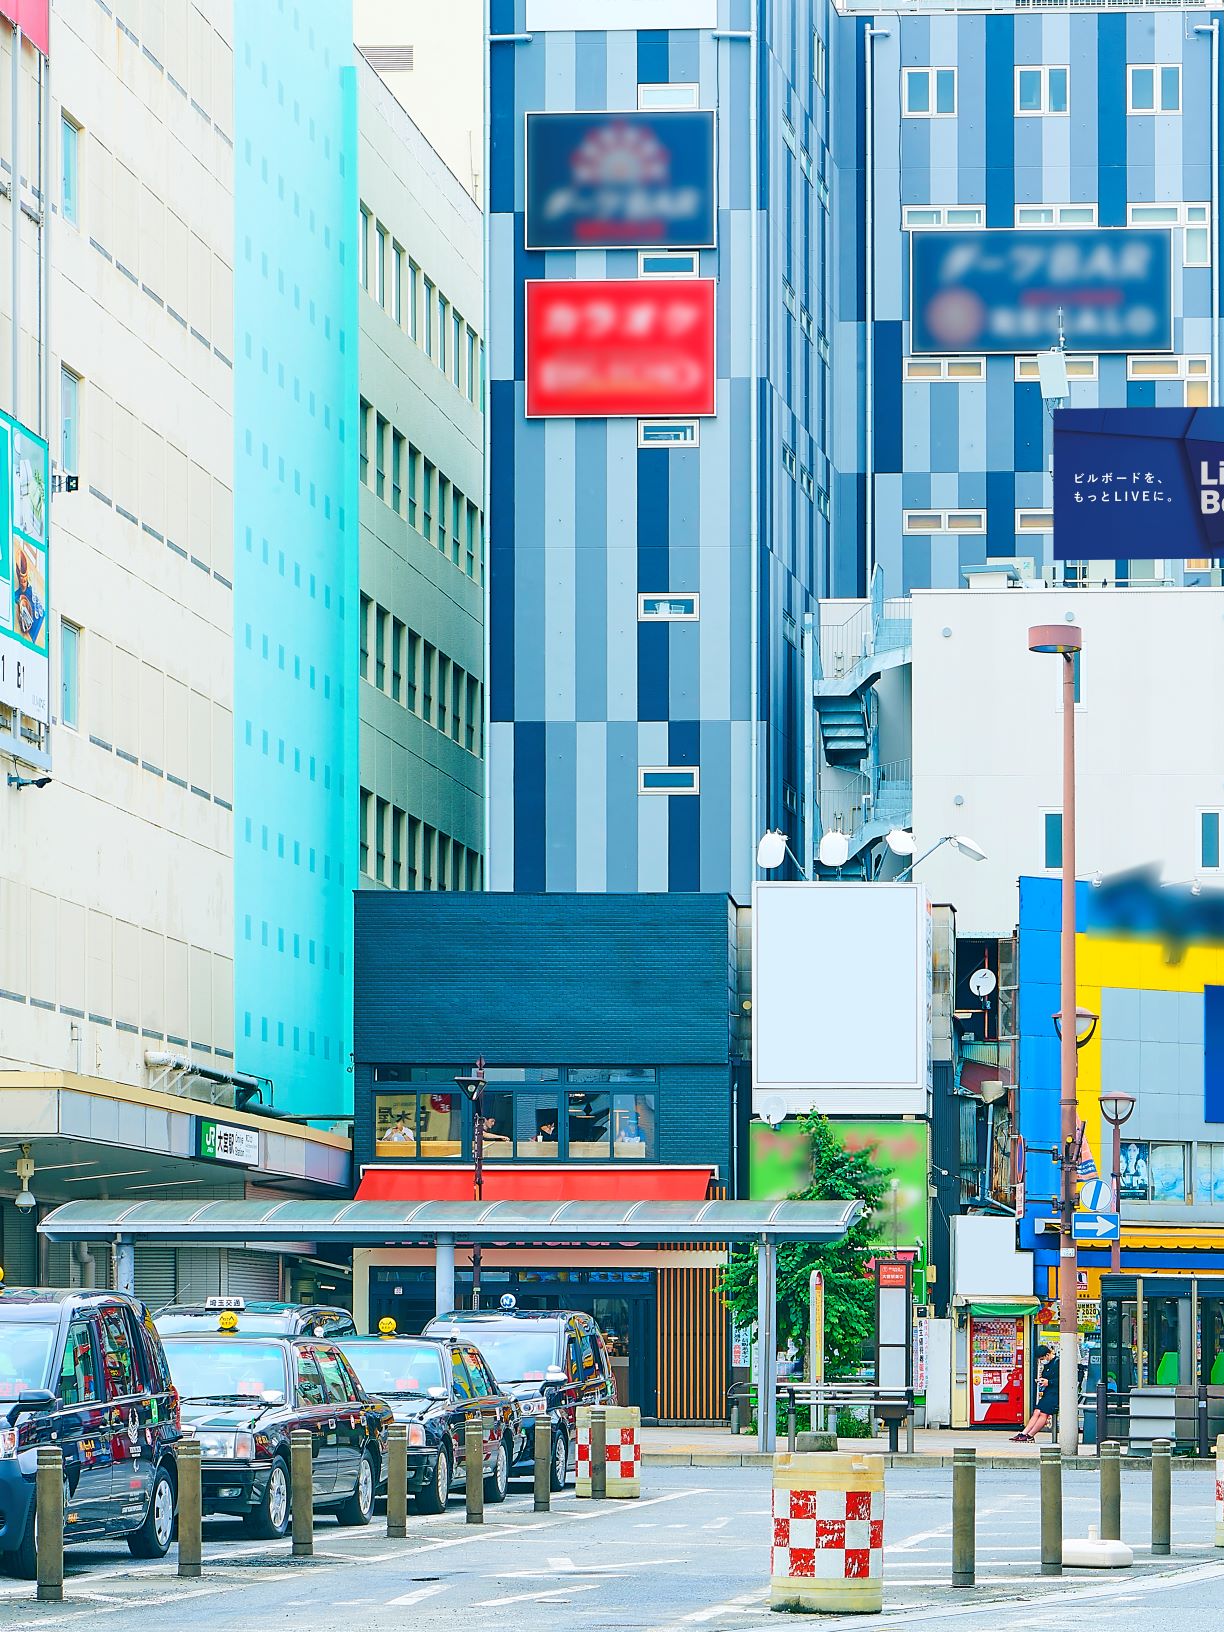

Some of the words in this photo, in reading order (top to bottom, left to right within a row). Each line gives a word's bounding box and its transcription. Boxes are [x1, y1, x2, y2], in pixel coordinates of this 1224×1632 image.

[1073, 472, 1165, 485] ビルボードを、
[1074, 490, 1173, 503] もっとLIVEに。
[206, 1126, 215, 1147] JR
